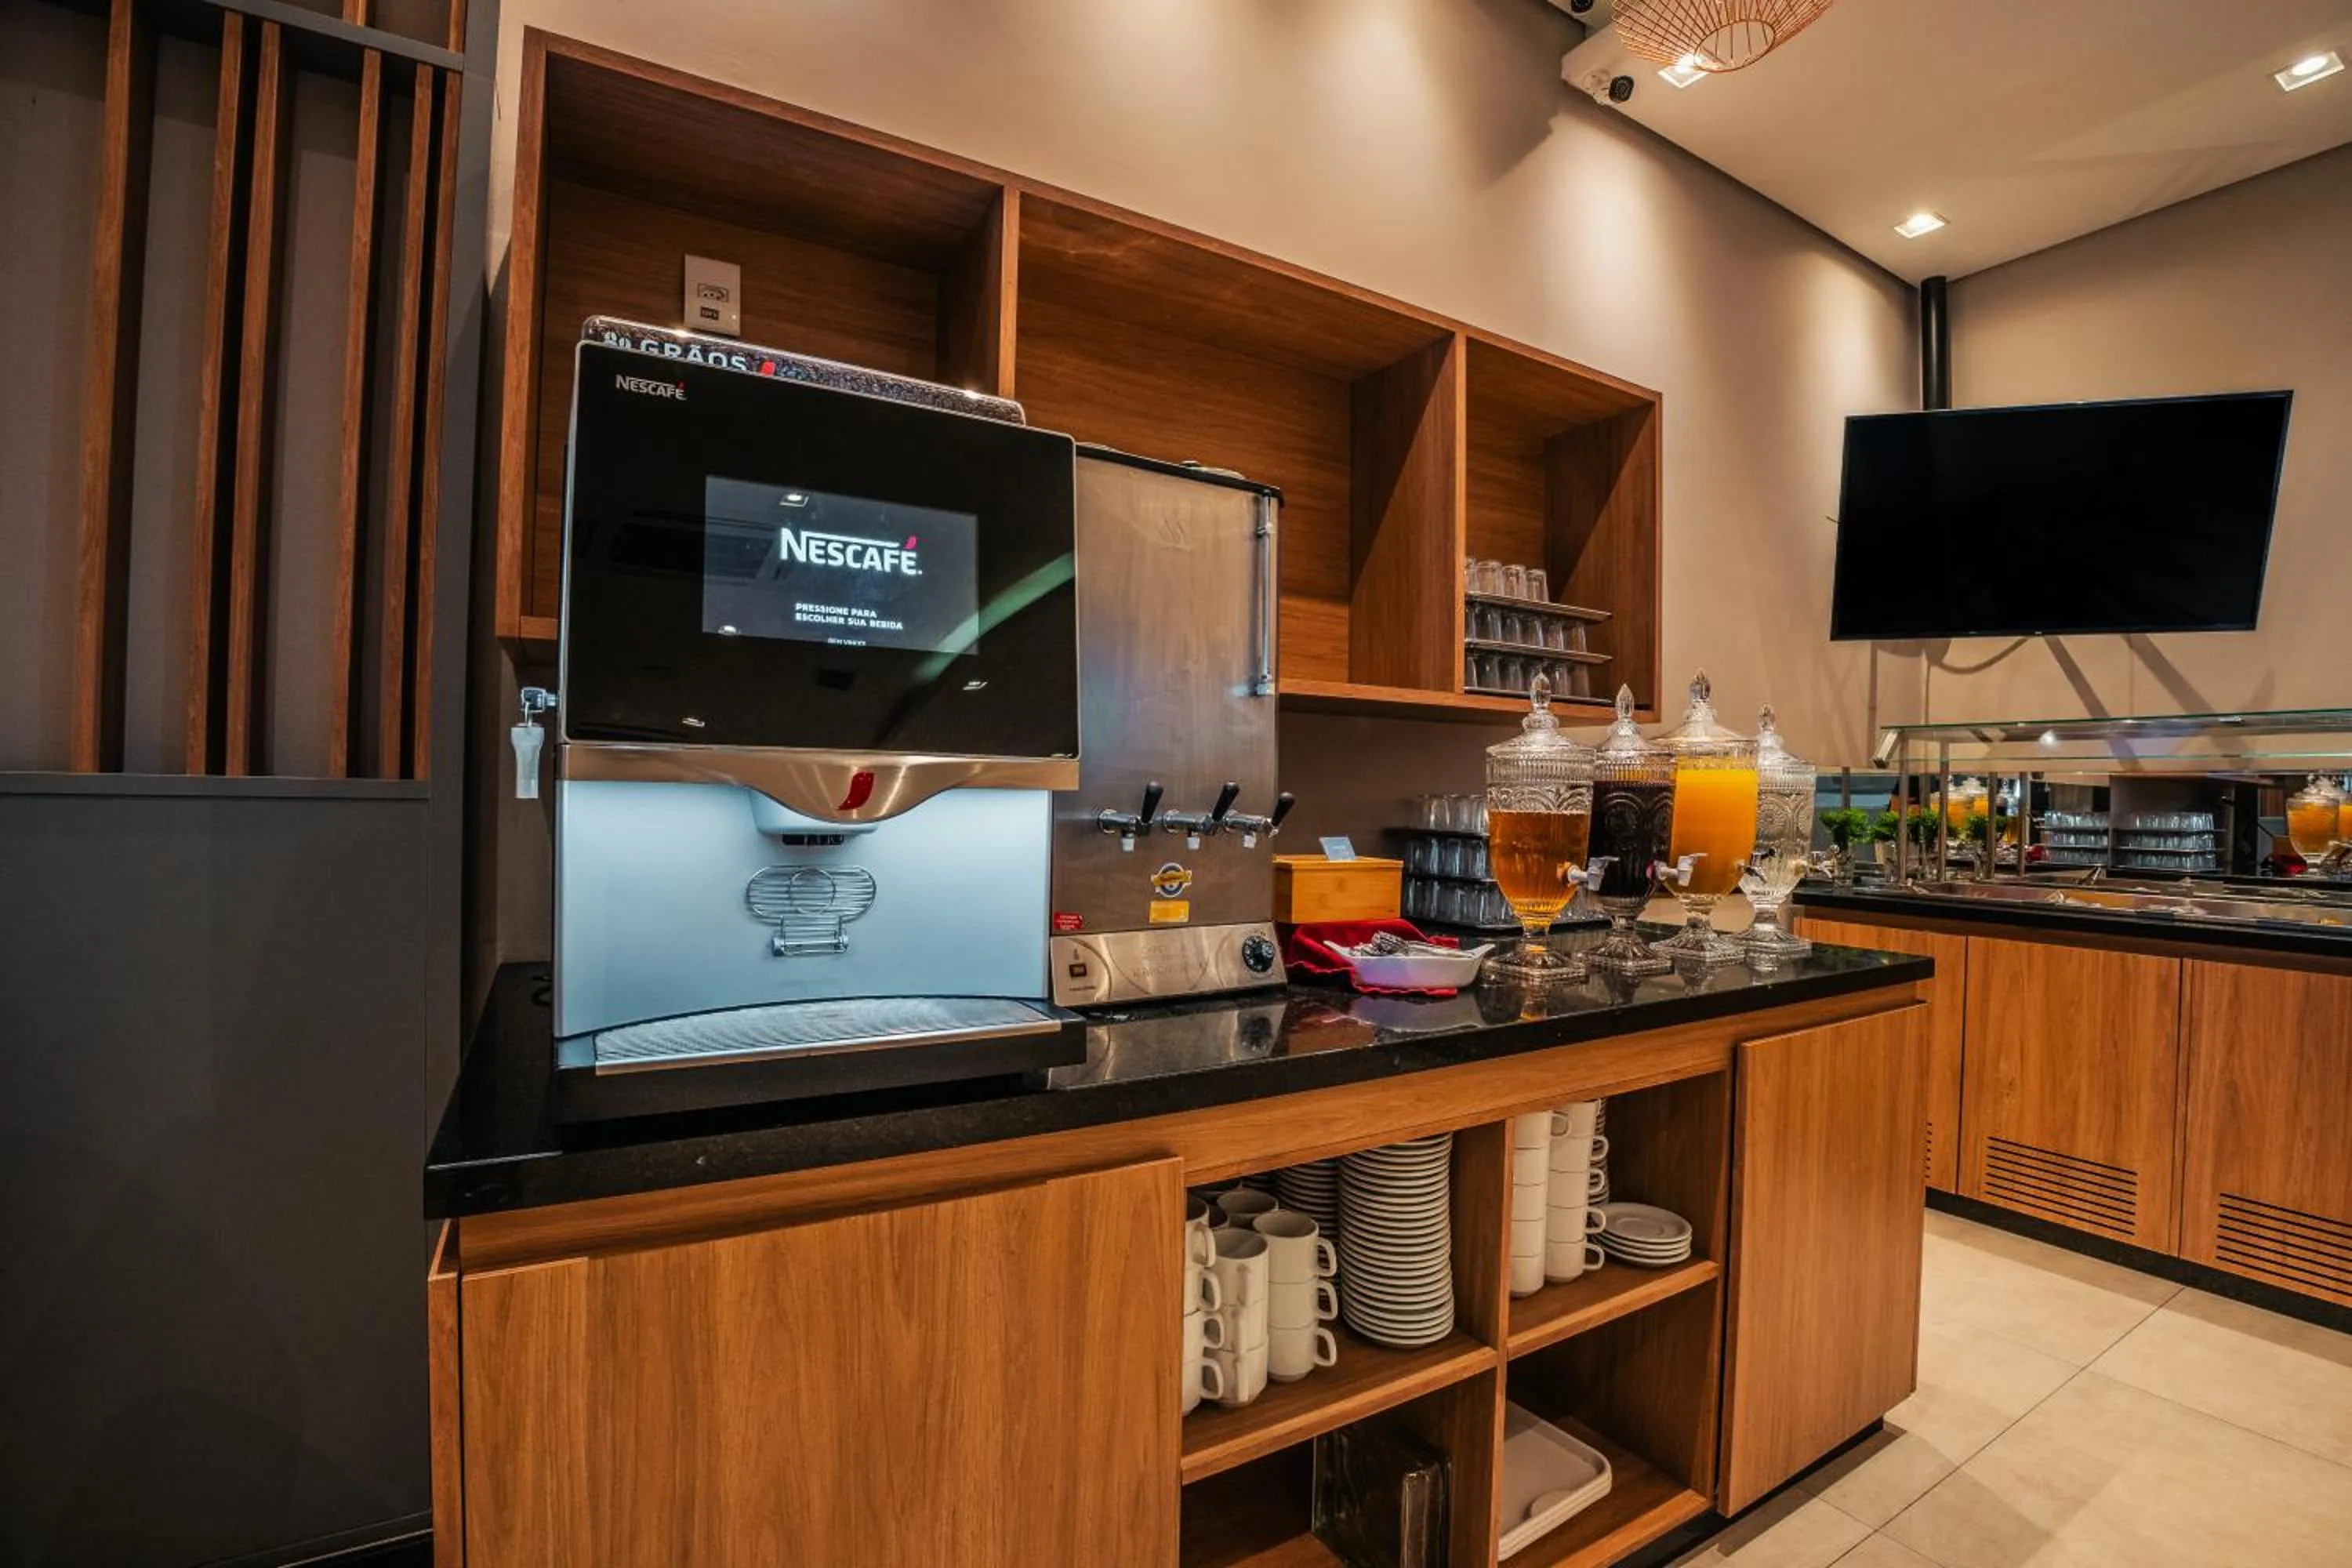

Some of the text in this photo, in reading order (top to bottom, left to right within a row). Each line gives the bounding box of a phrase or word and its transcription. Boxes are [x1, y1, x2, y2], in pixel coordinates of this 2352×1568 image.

[796, 603, 877, 618] PRESSIONE PARA
[795, 613, 903, 630] ESCOLHER SUA BEBIDA
